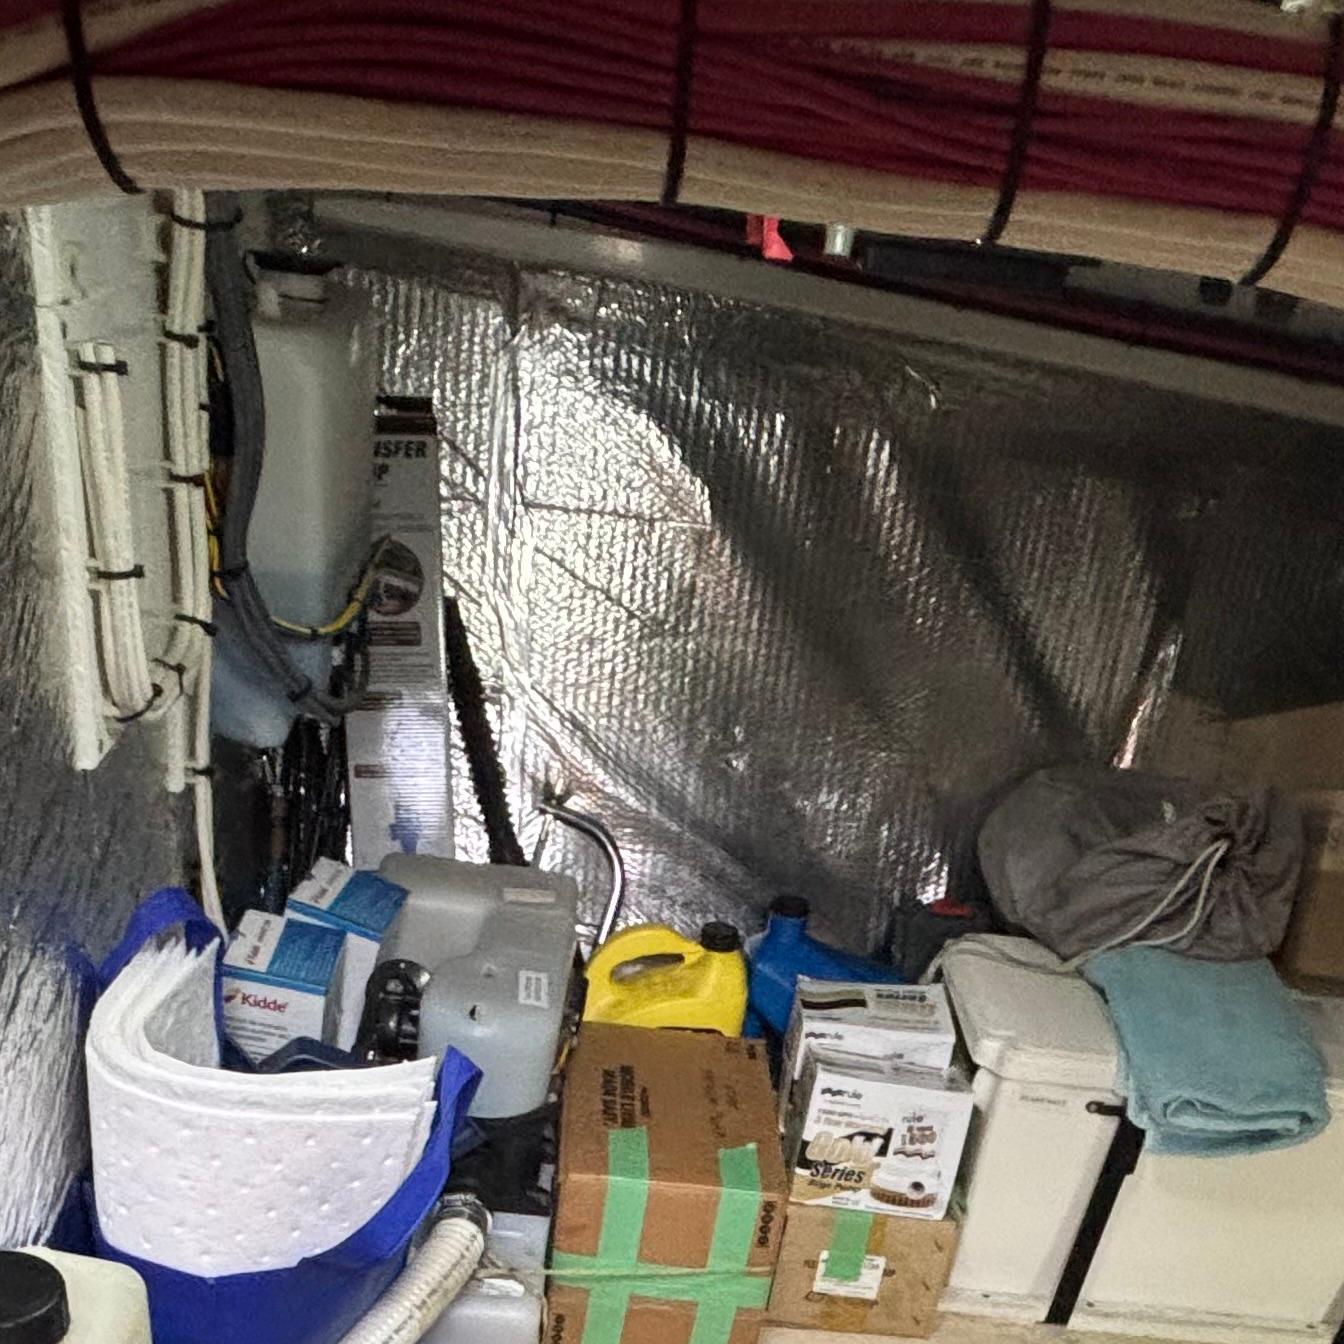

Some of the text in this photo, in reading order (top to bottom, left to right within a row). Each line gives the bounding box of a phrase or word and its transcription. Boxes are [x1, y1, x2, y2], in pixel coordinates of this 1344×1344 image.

[372, 440, 427, 458] NSFER
[241, 992, 288, 1012] Kidde
[810, 1160, 866, 1184] Series
